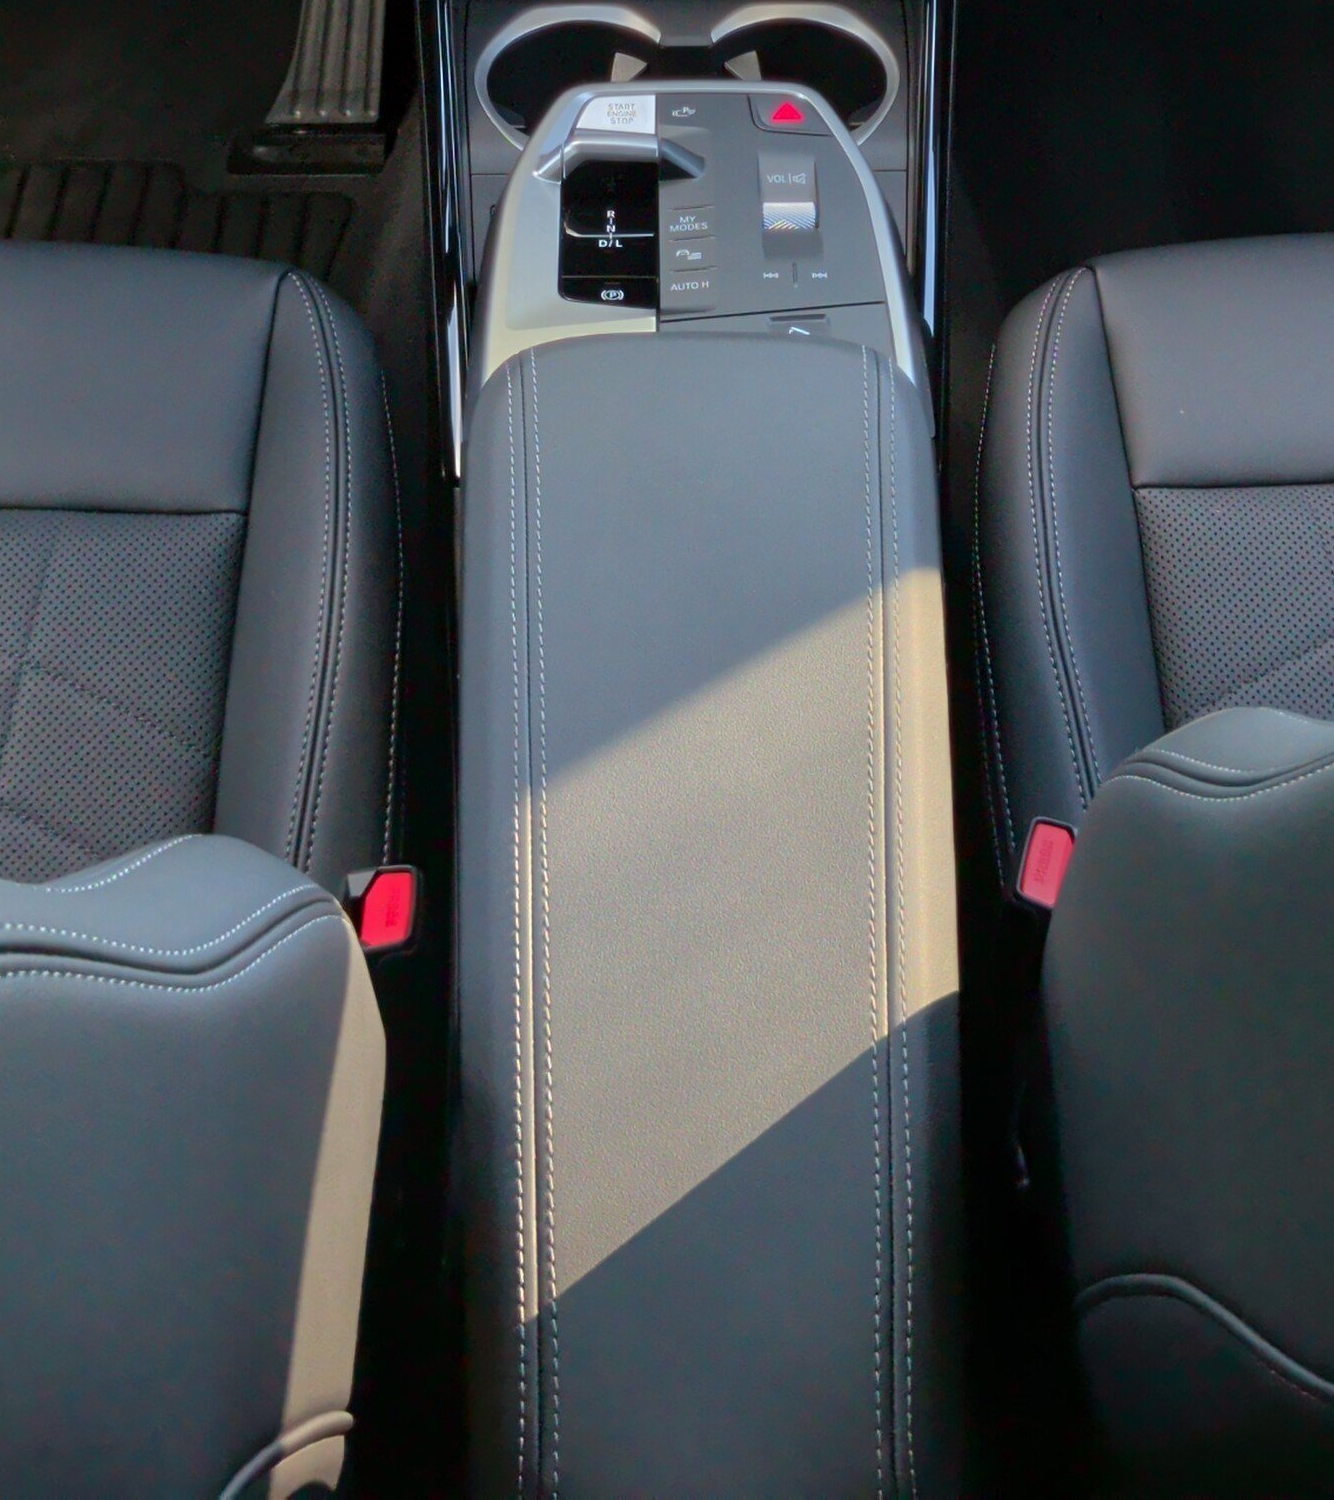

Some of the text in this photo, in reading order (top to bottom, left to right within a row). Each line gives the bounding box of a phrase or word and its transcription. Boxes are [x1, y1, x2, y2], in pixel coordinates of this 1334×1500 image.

[607, 103, 636, 111] START
[610, 117, 635, 125] STOP
[766, 173, 786, 184] VOL
[606, 210, 616, 218] R
[679, 215, 697, 224] MY
[606, 225, 616, 233] N
[669, 222, 708, 233] MODES
[670, 280, 710, 292] AUTO H
